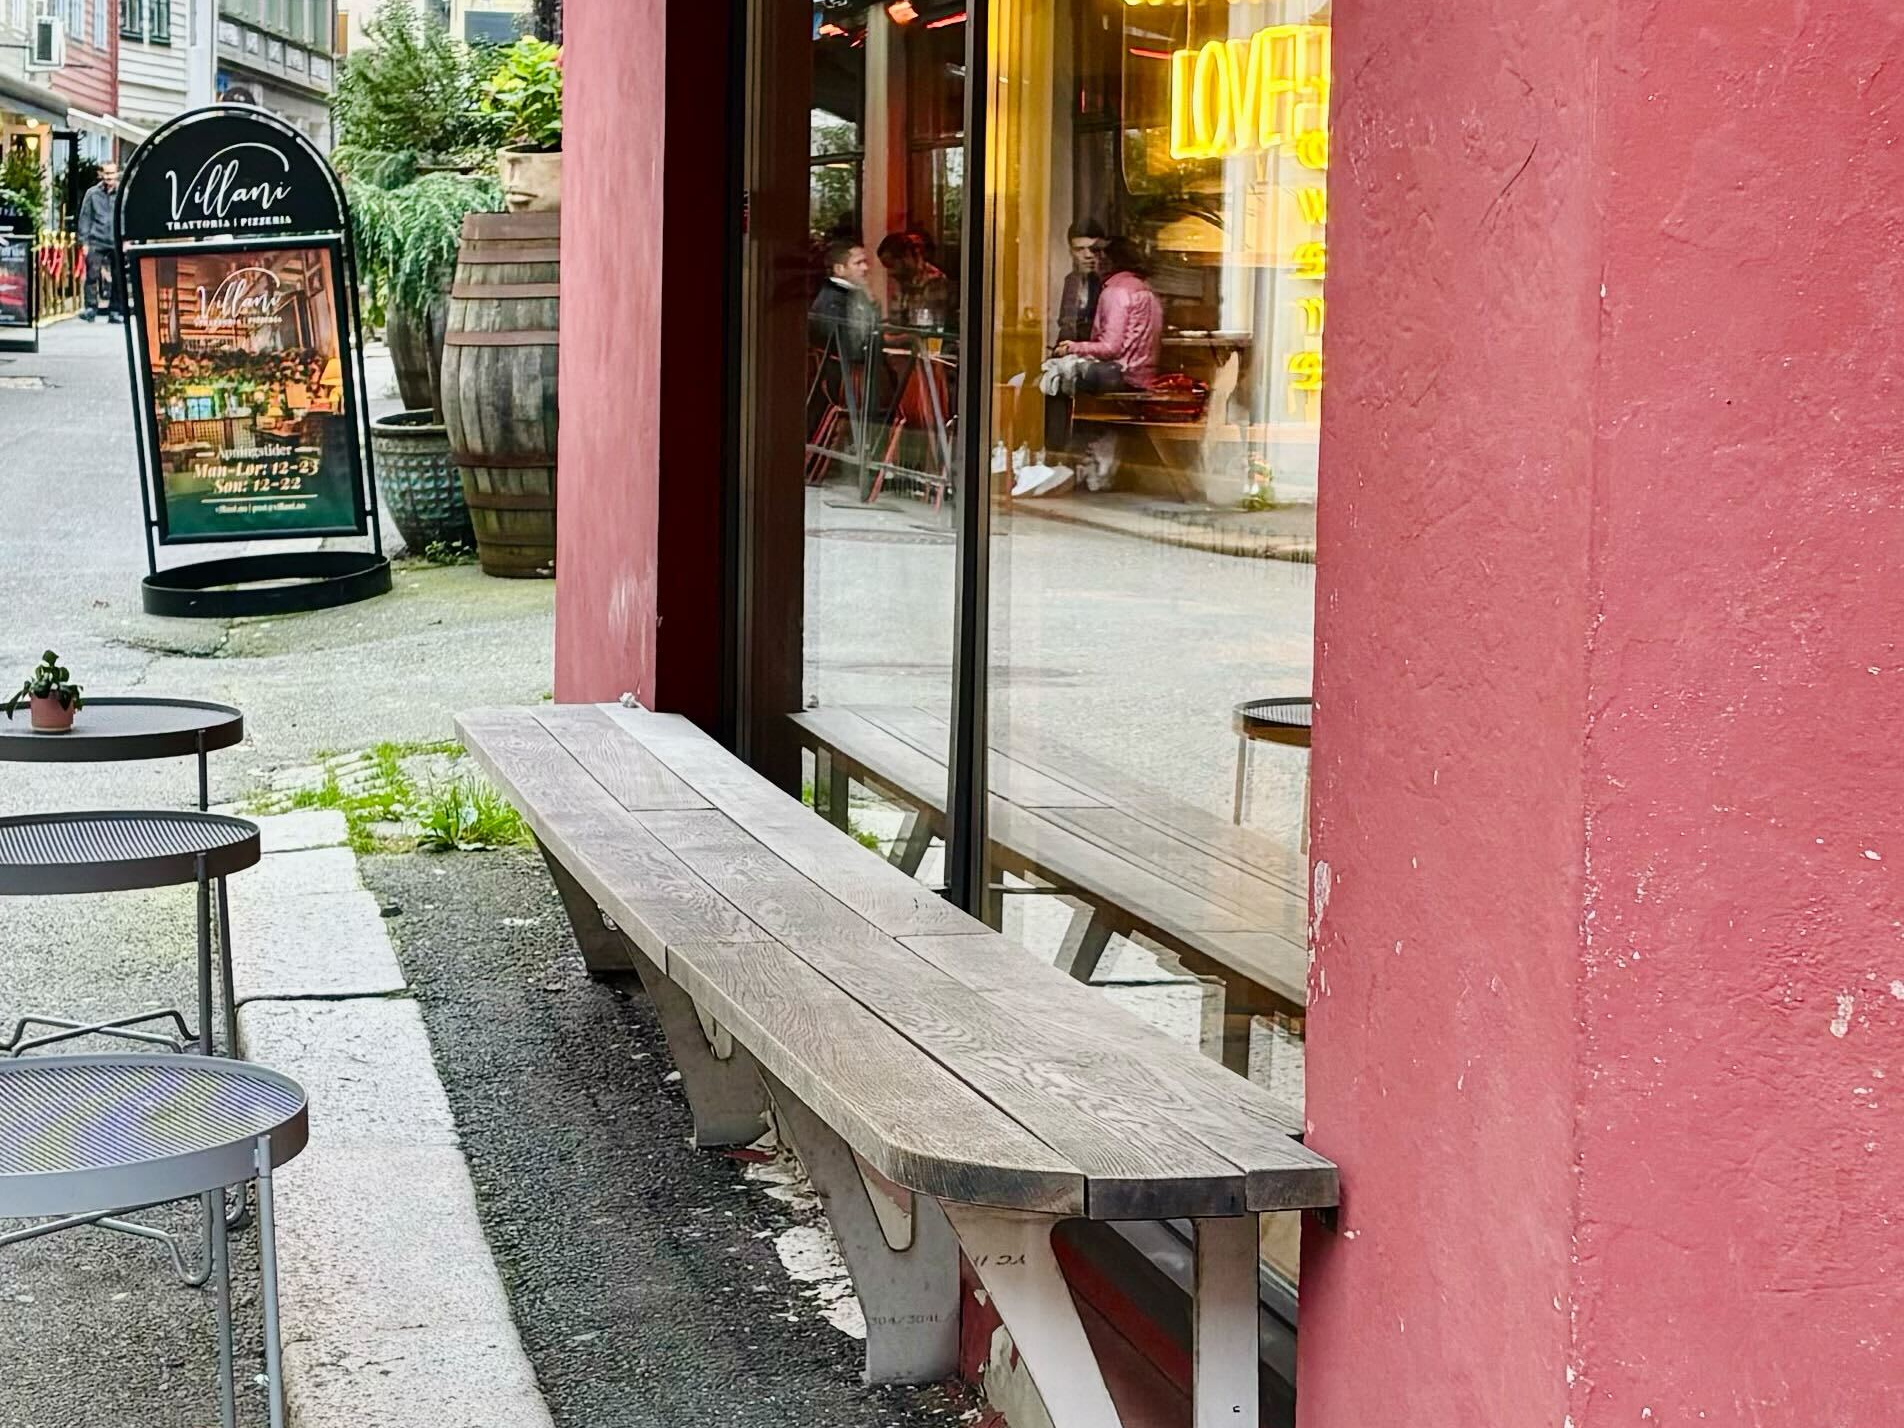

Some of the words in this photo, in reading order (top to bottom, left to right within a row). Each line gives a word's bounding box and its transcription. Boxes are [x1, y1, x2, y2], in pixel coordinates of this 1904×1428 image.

[164, 142, 292, 221] Villani
[166, 218, 231, 232] TRATTORIA
[240, 215, 293, 228] PIZZERIA
[196, 267, 282, 318] Villani
[253, 476, 303, 492] 12-22
